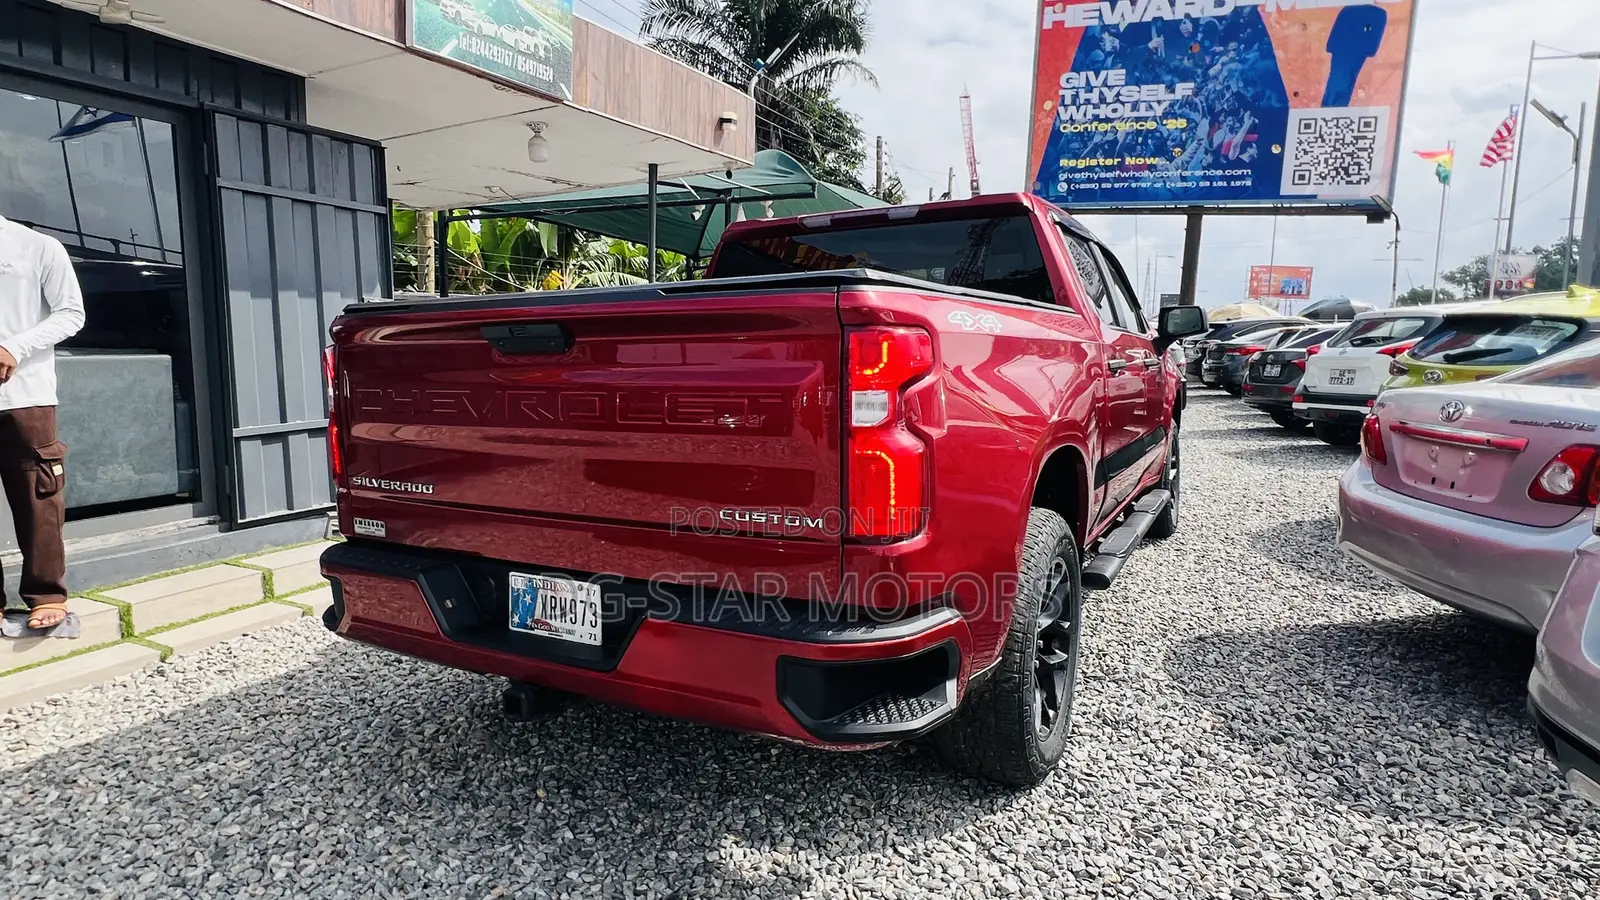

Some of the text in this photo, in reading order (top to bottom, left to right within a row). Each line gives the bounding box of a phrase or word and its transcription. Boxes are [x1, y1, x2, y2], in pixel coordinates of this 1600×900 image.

[1059, 69, 1126, 88] GIVE
[1058, 83, 1195, 105] THYSELF
[1058, 101, 1170, 121] WHOLLY
[1060, 121, 1158, 133] Conference
[1060, 157, 1121, 169] Register
[1058, 169, 1252, 181] givethyselfwhollyconference.com
[356, 388, 783, 428] CHEVROLET
[353, 476, 434, 494] SILVERADO
[719, 508, 824, 529] CUSTOM
[588, 632, 598, 641] 71
